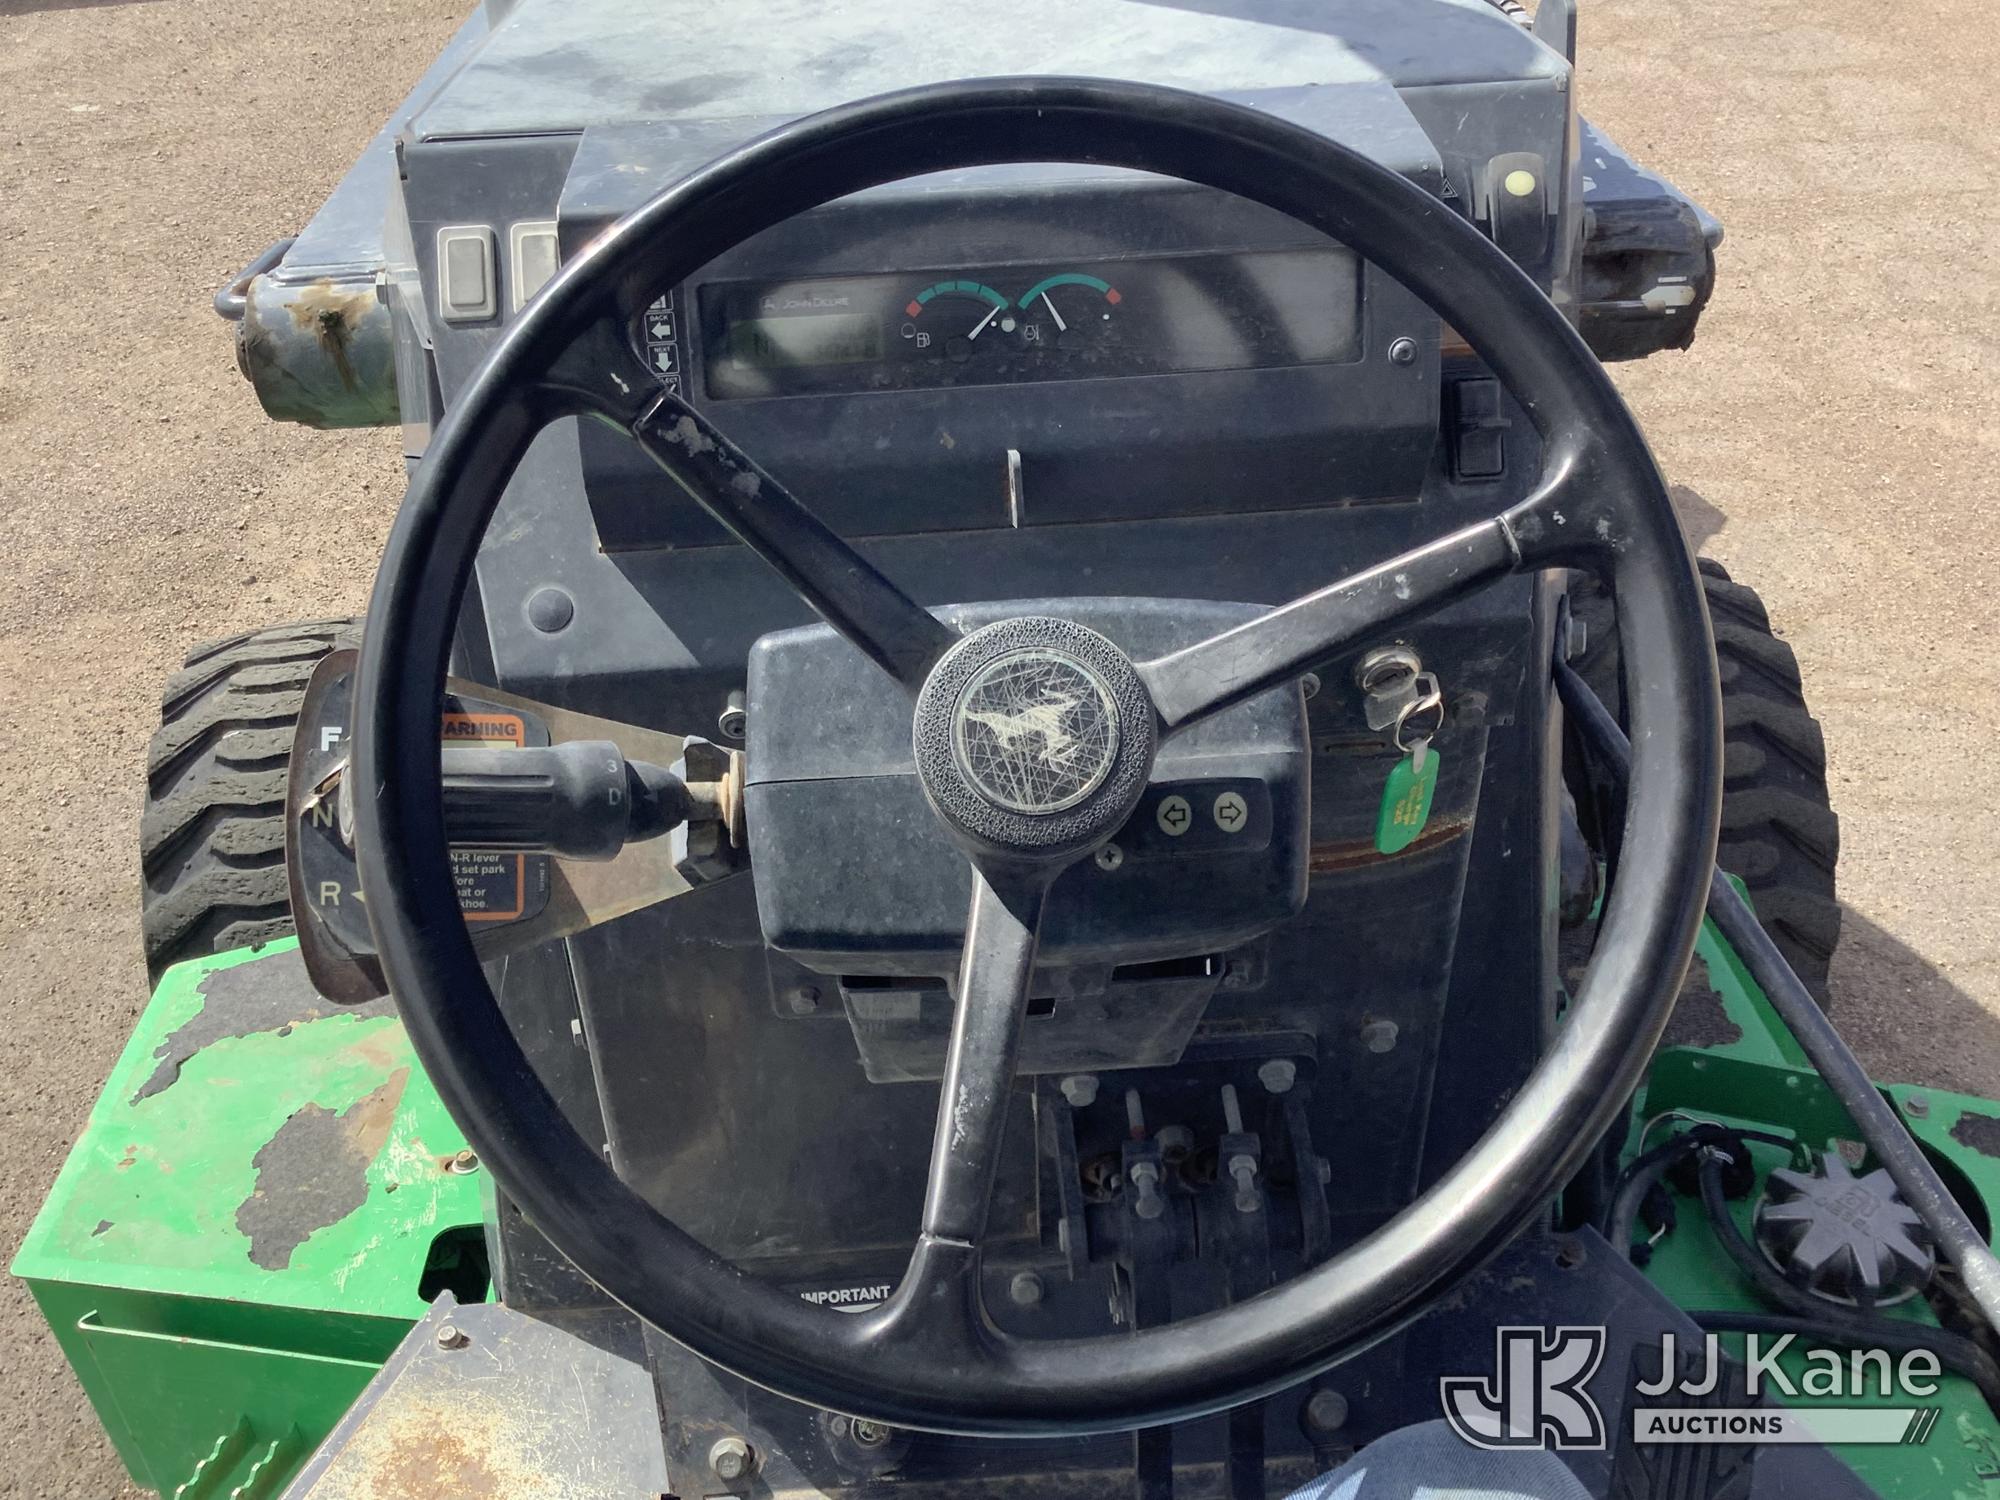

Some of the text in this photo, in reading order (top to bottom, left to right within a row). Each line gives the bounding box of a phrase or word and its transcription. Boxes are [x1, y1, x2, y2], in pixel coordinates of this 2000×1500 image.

[444, 721, 517, 736] ARNING
[321, 726, 342, 752] F
[606, 759, 618, 773] 3
[313, 803, 333, 828] N
[473, 853, 500, 862] lever
[462, 865, 479, 874] set
[481, 864, 505, 876] park
[320, 881, 342, 906] R
[474, 889, 486, 897] or
